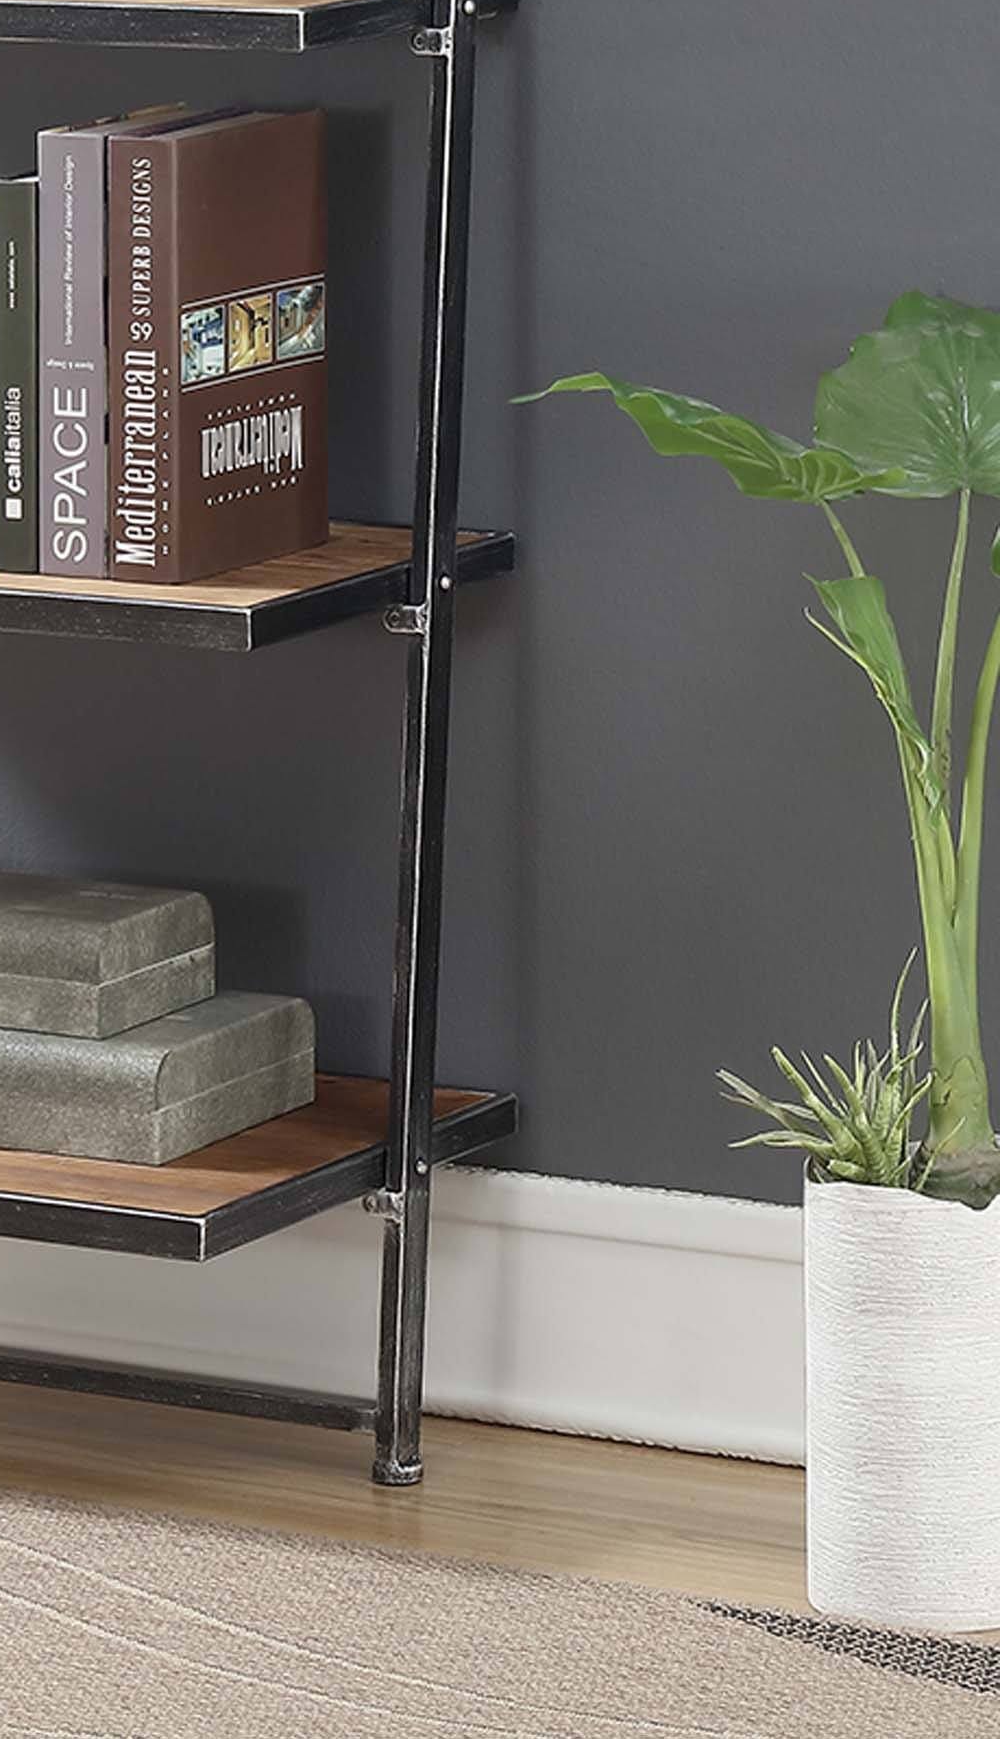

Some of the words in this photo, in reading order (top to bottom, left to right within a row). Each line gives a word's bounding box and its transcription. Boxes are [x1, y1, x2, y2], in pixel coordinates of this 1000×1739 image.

[64, 155, 75, 191] Design
[132, 158, 151, 238] DESIGNS
[64, 192, 74, 229] Interior
[64, 243, 74, 281] Review
[132, 246, 151, 317] SUPERB
[64, 283, 74, 346] International
[53, 387, 87, 563] SPACE
[115, 350, 156, 567] Mediterranean
